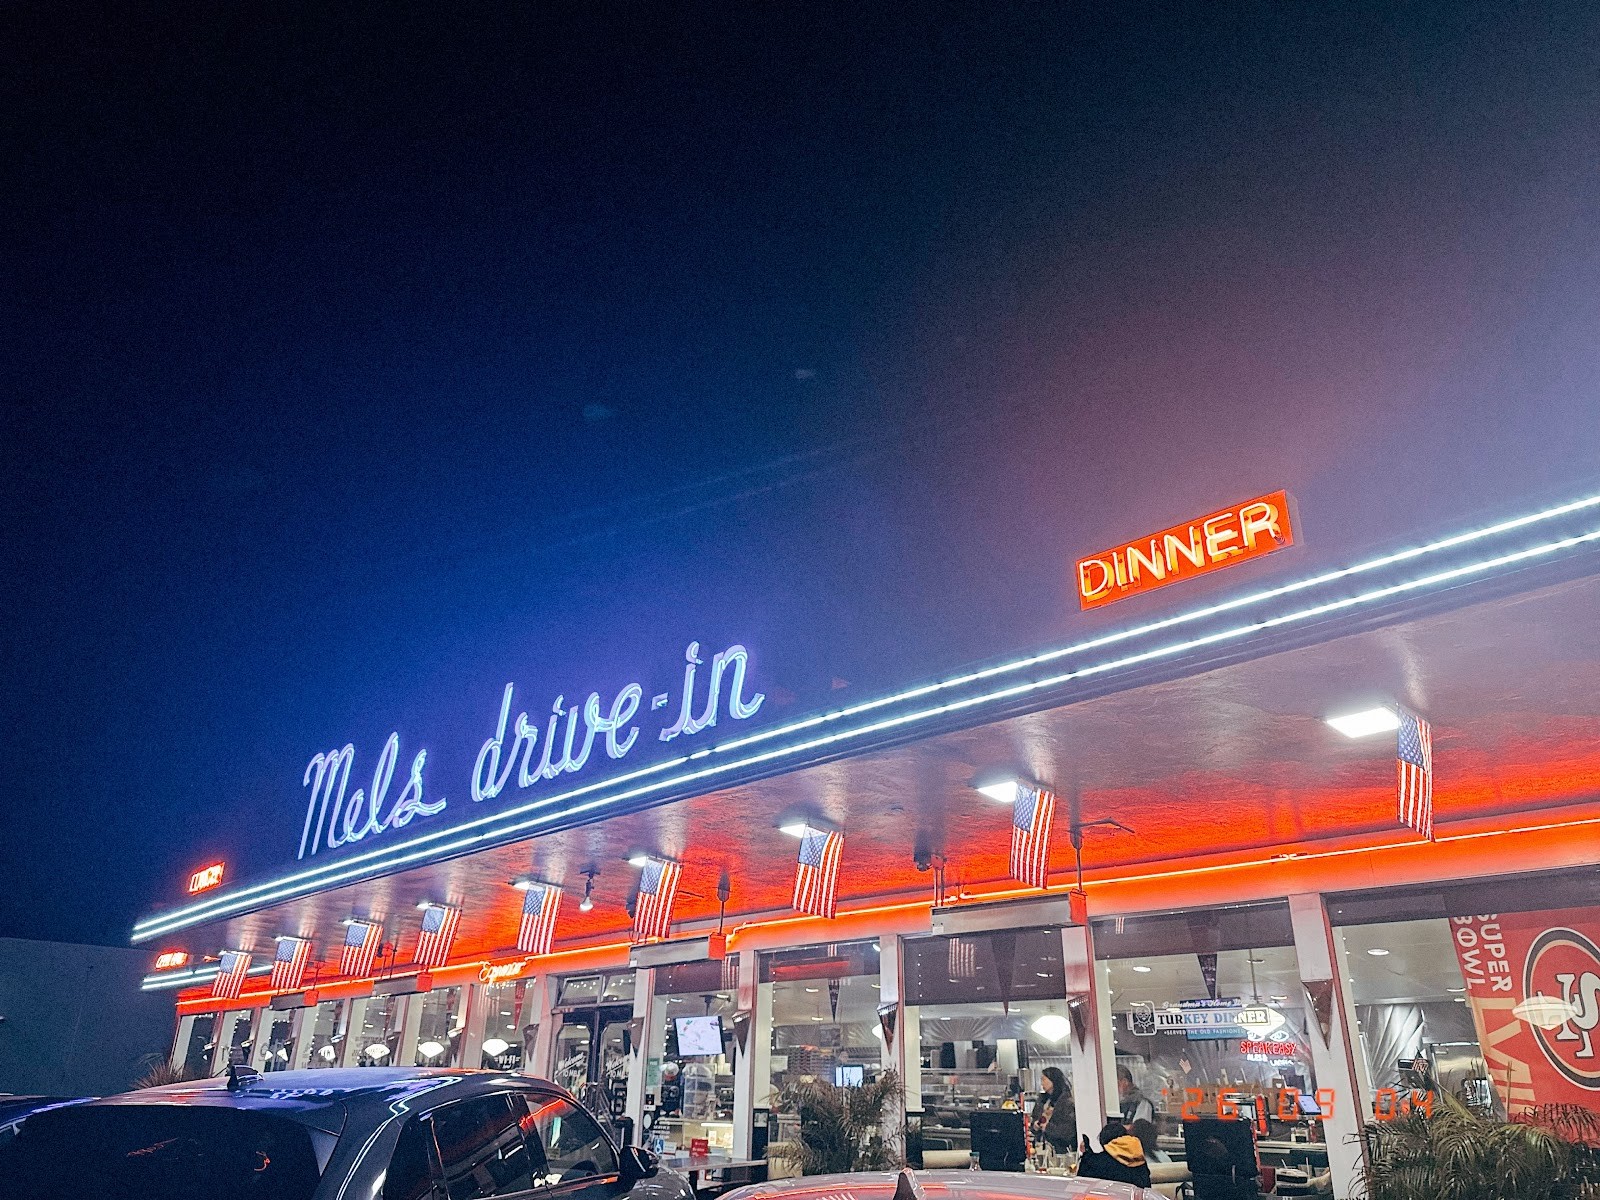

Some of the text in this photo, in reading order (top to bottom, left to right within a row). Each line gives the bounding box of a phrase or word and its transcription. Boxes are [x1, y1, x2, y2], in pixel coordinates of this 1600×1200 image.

[1079, 502, 1285, 604] DINNER
[298, 640, 766, 860] Mels drive-in
[1157, 1010, 1268, 1025] TURKEY DINNER
[1240, 1041, 1297, 1056] SPEAKEASY
